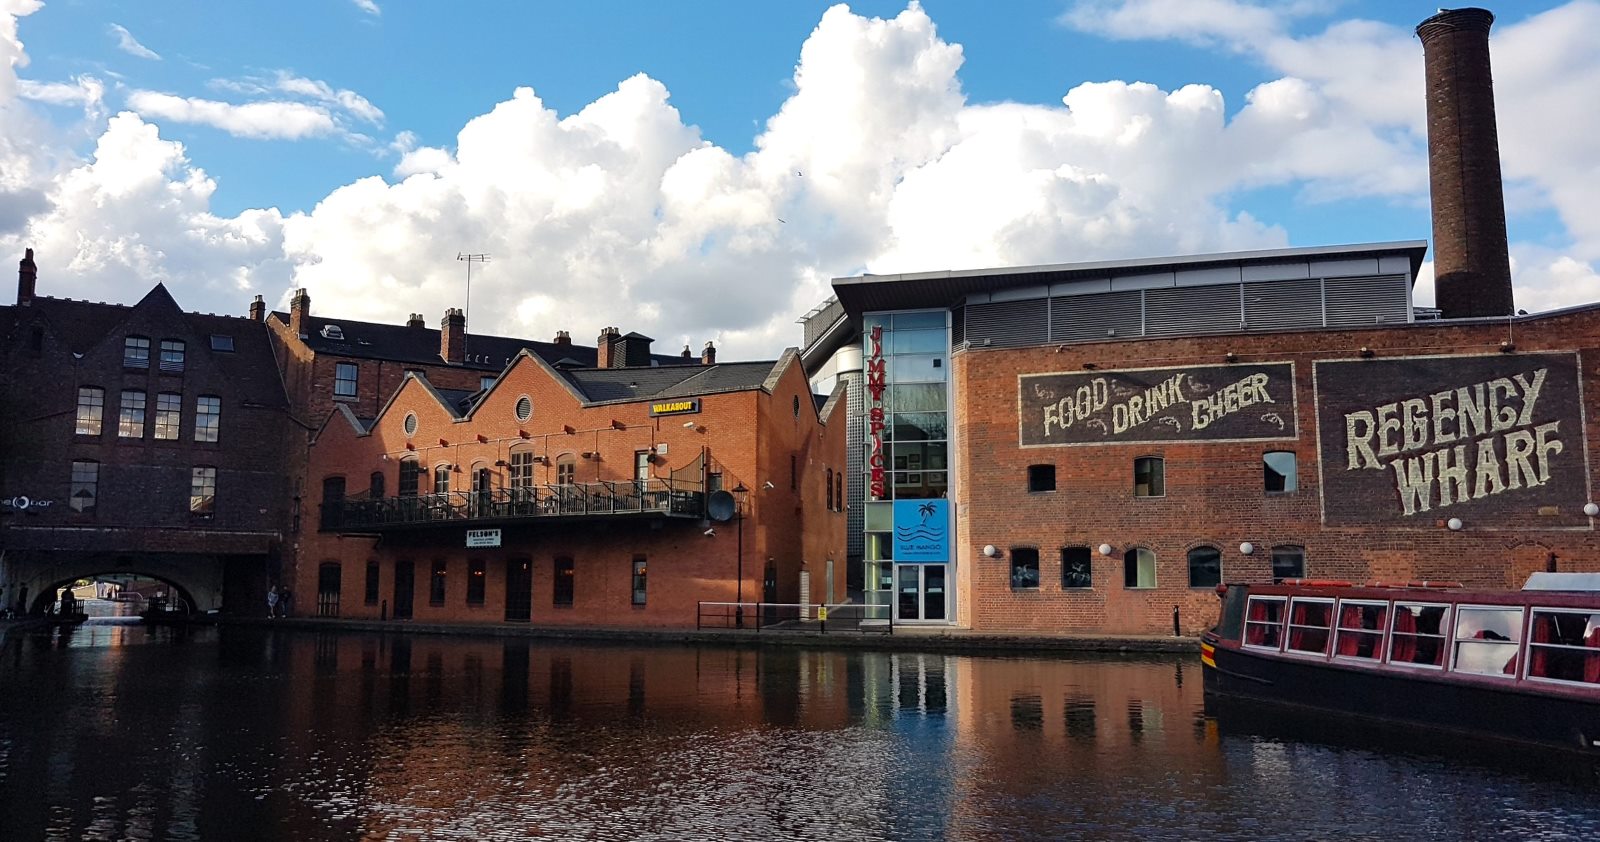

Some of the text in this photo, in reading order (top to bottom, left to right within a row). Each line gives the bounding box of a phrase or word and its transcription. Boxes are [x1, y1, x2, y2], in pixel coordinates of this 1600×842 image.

[652, 402, 692, 413] WALKABOUT
[867, 325, 887, 497] JIMMY SPICES
[1044, 373, 1275, 437] FOOD DRINK CHEER
[1344, 368, 1548, 470] REGENCY
[1390, 420, 1563, 516] WHARF
